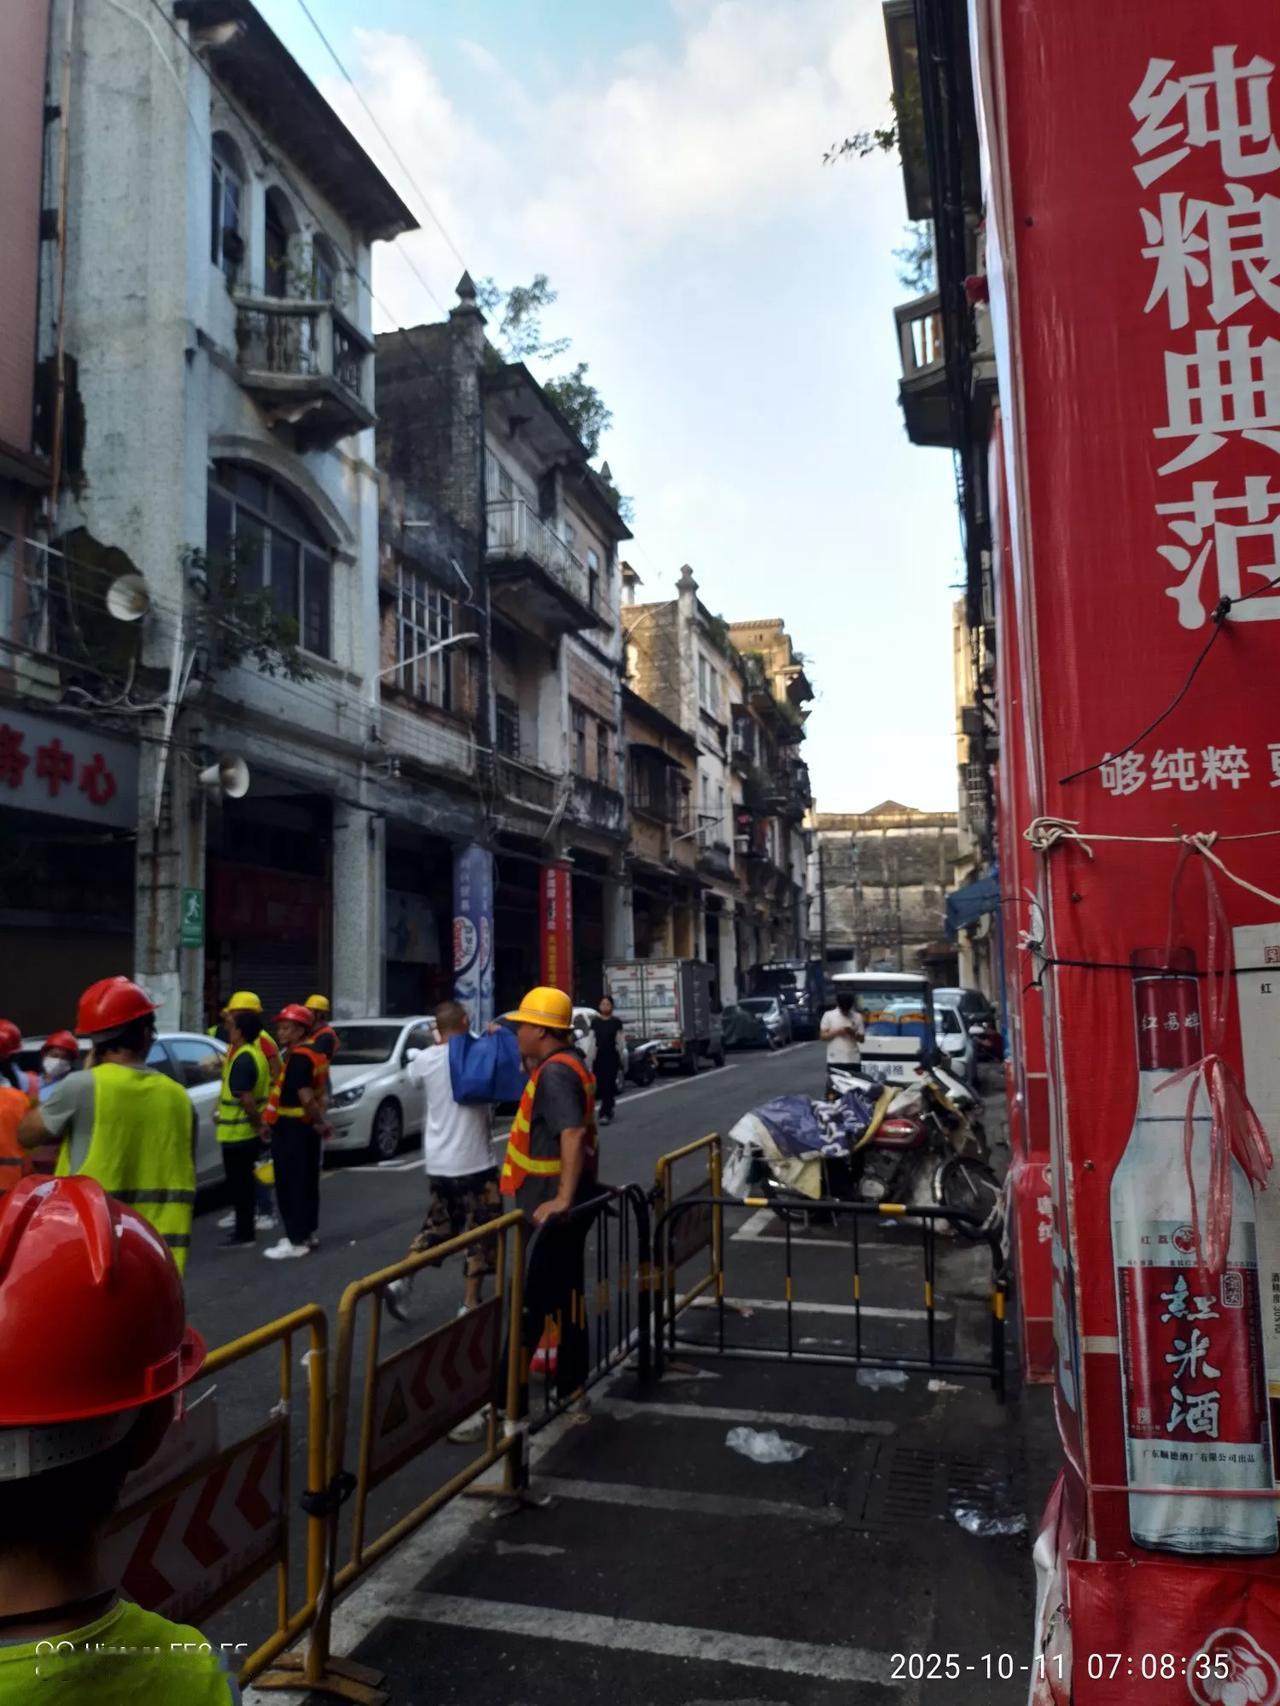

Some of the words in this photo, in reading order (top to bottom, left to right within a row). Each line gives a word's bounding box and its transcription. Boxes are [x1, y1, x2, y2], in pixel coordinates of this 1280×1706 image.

[1128, 44, 1280, 630] 纯粮典范
[1099, 744, 1251, 796] 够纯粹
